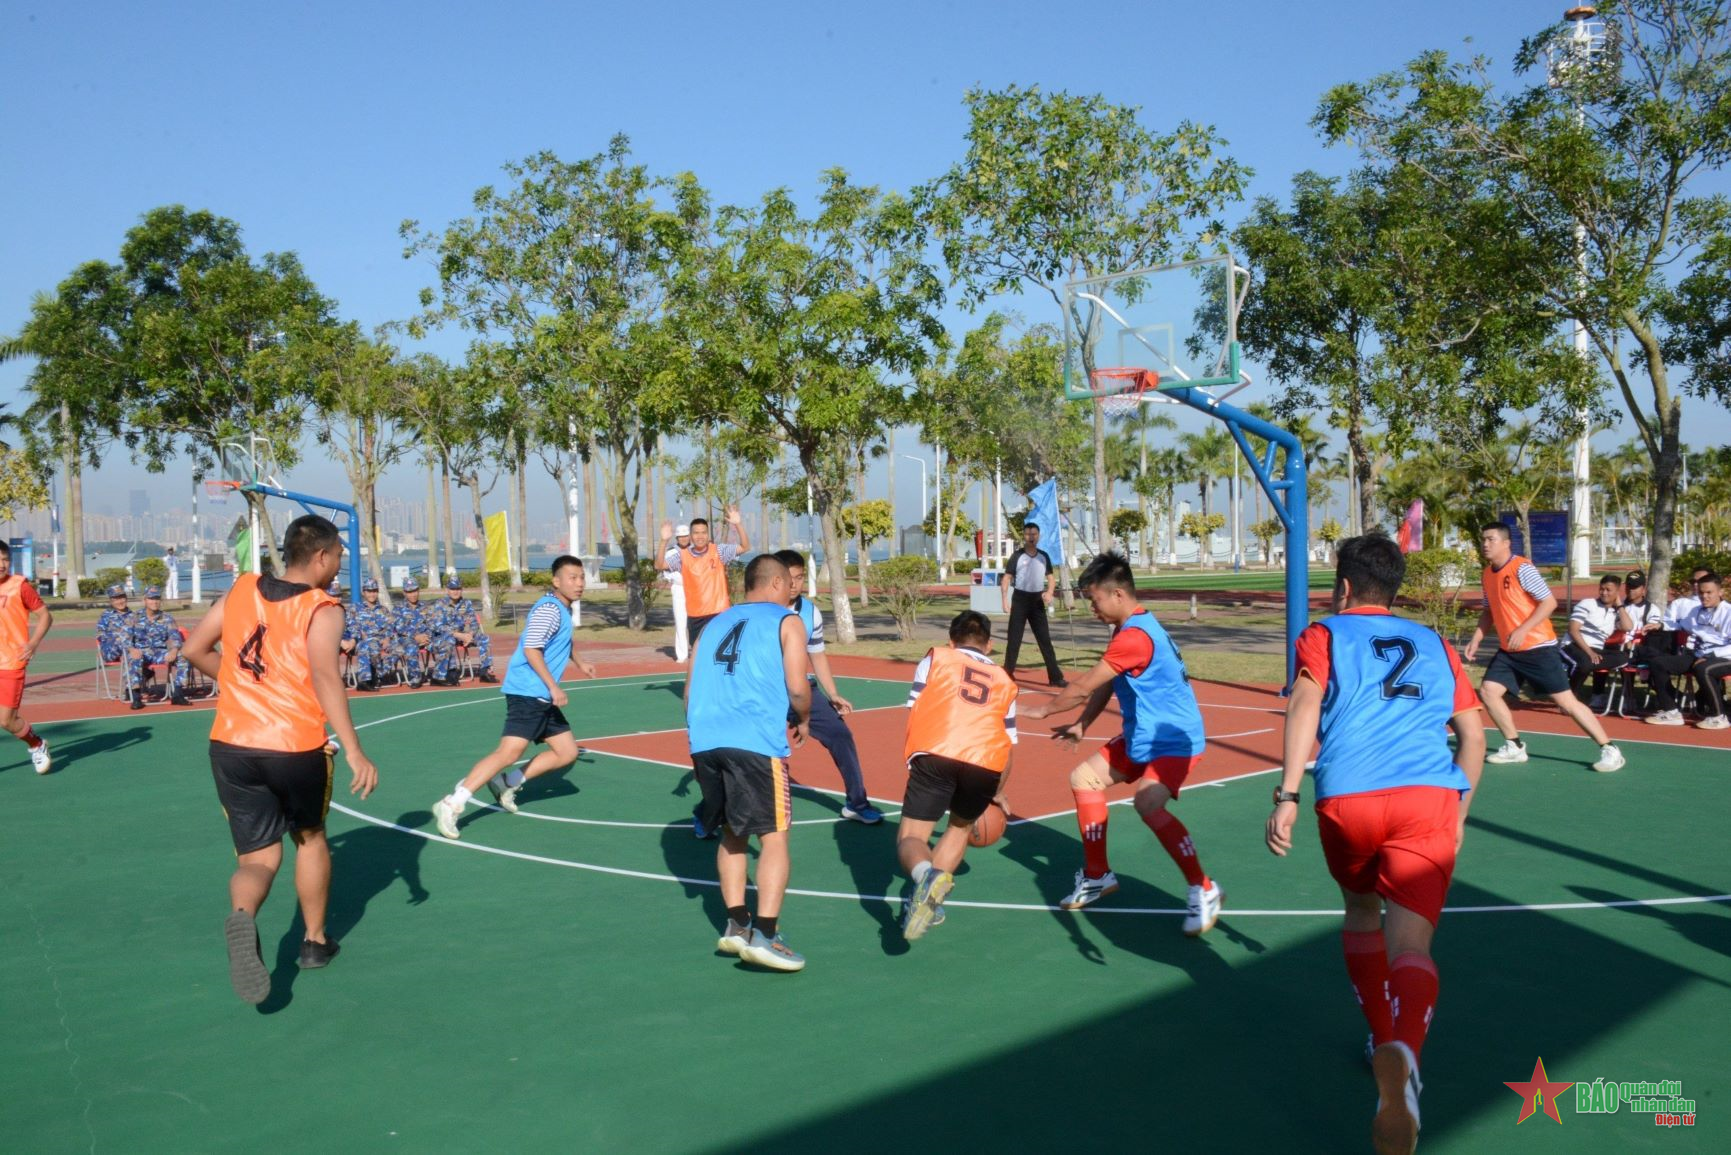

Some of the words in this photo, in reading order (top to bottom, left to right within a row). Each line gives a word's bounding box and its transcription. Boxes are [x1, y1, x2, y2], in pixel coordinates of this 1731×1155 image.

[237, 622, 268, 683] 4
[713, 618, 749, 676] 4
[1369, 635, 1424, 701] 2
[958, 664, 993, 707] 5
